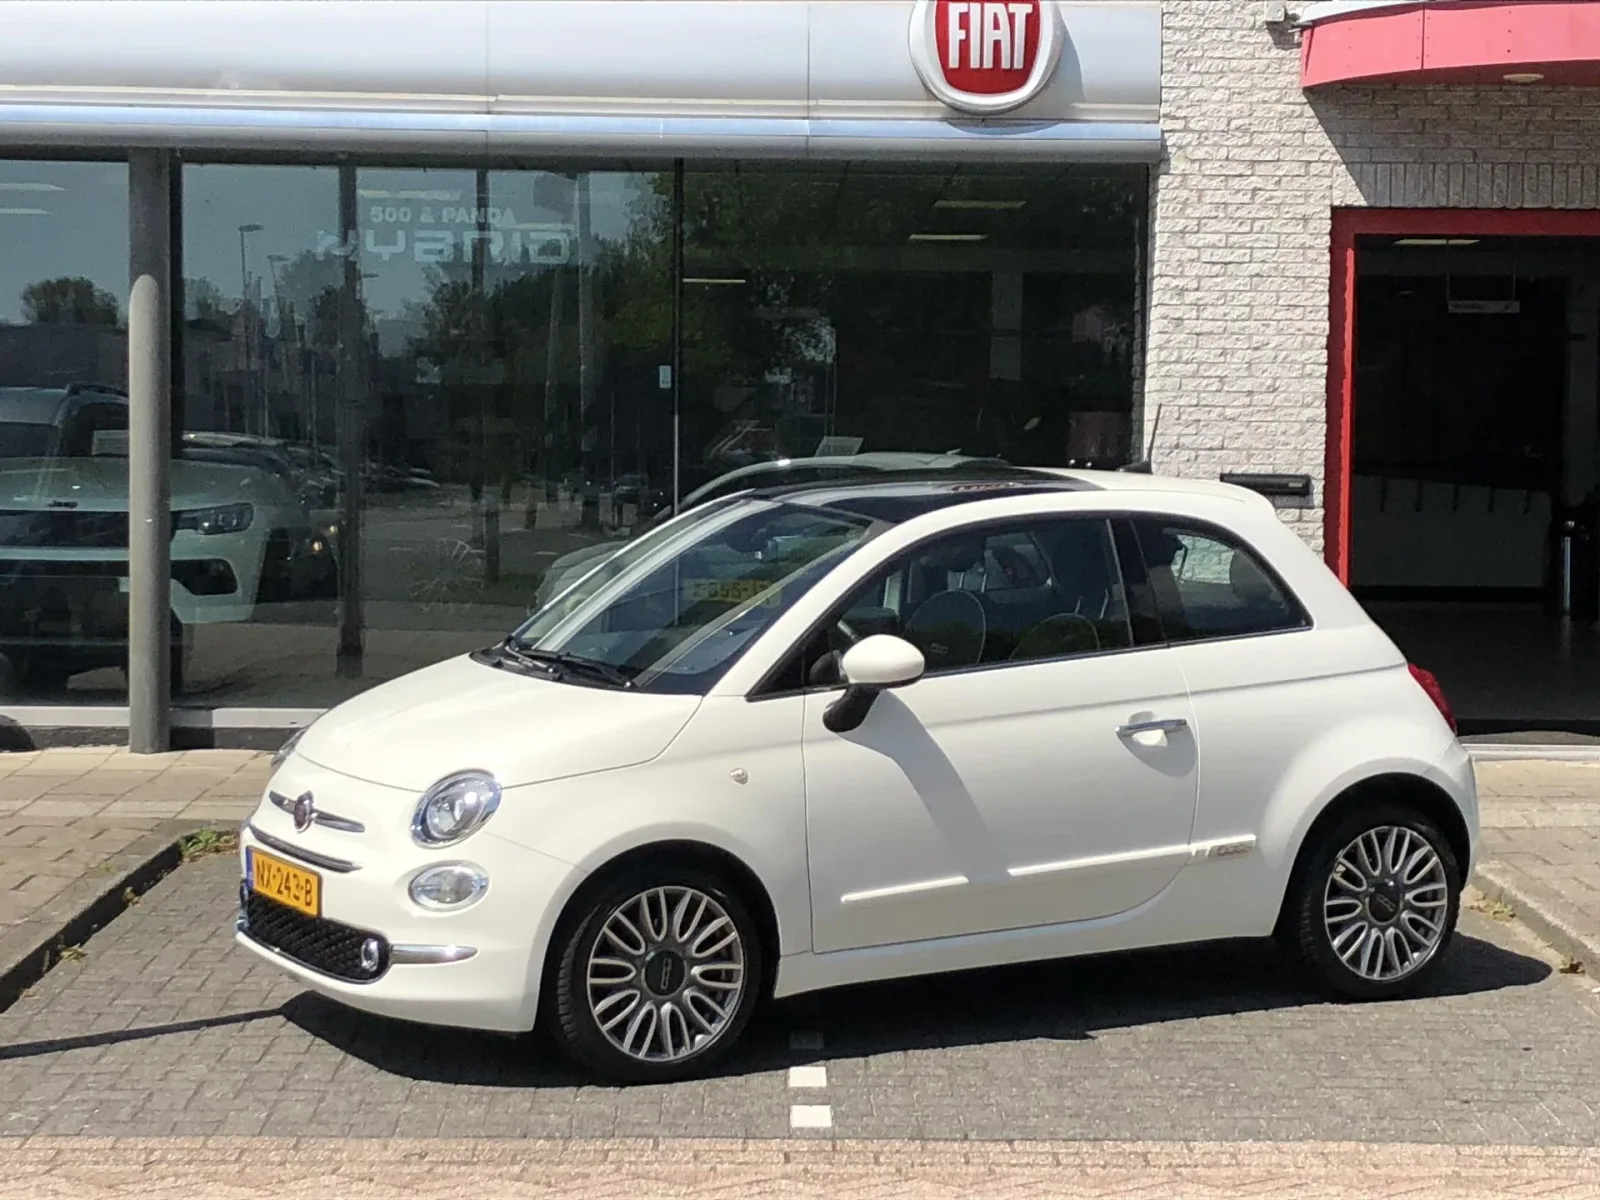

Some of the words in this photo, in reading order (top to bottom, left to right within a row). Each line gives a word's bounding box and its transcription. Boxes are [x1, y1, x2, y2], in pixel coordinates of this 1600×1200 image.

[948, 2, 1033, 70] FIAT
[369, 206, 412, 223] 500
[419, 206, 435, 223] &
[441, 206, 517, 224] PANDA
[256, 859, 313, 907] NX-243-B
